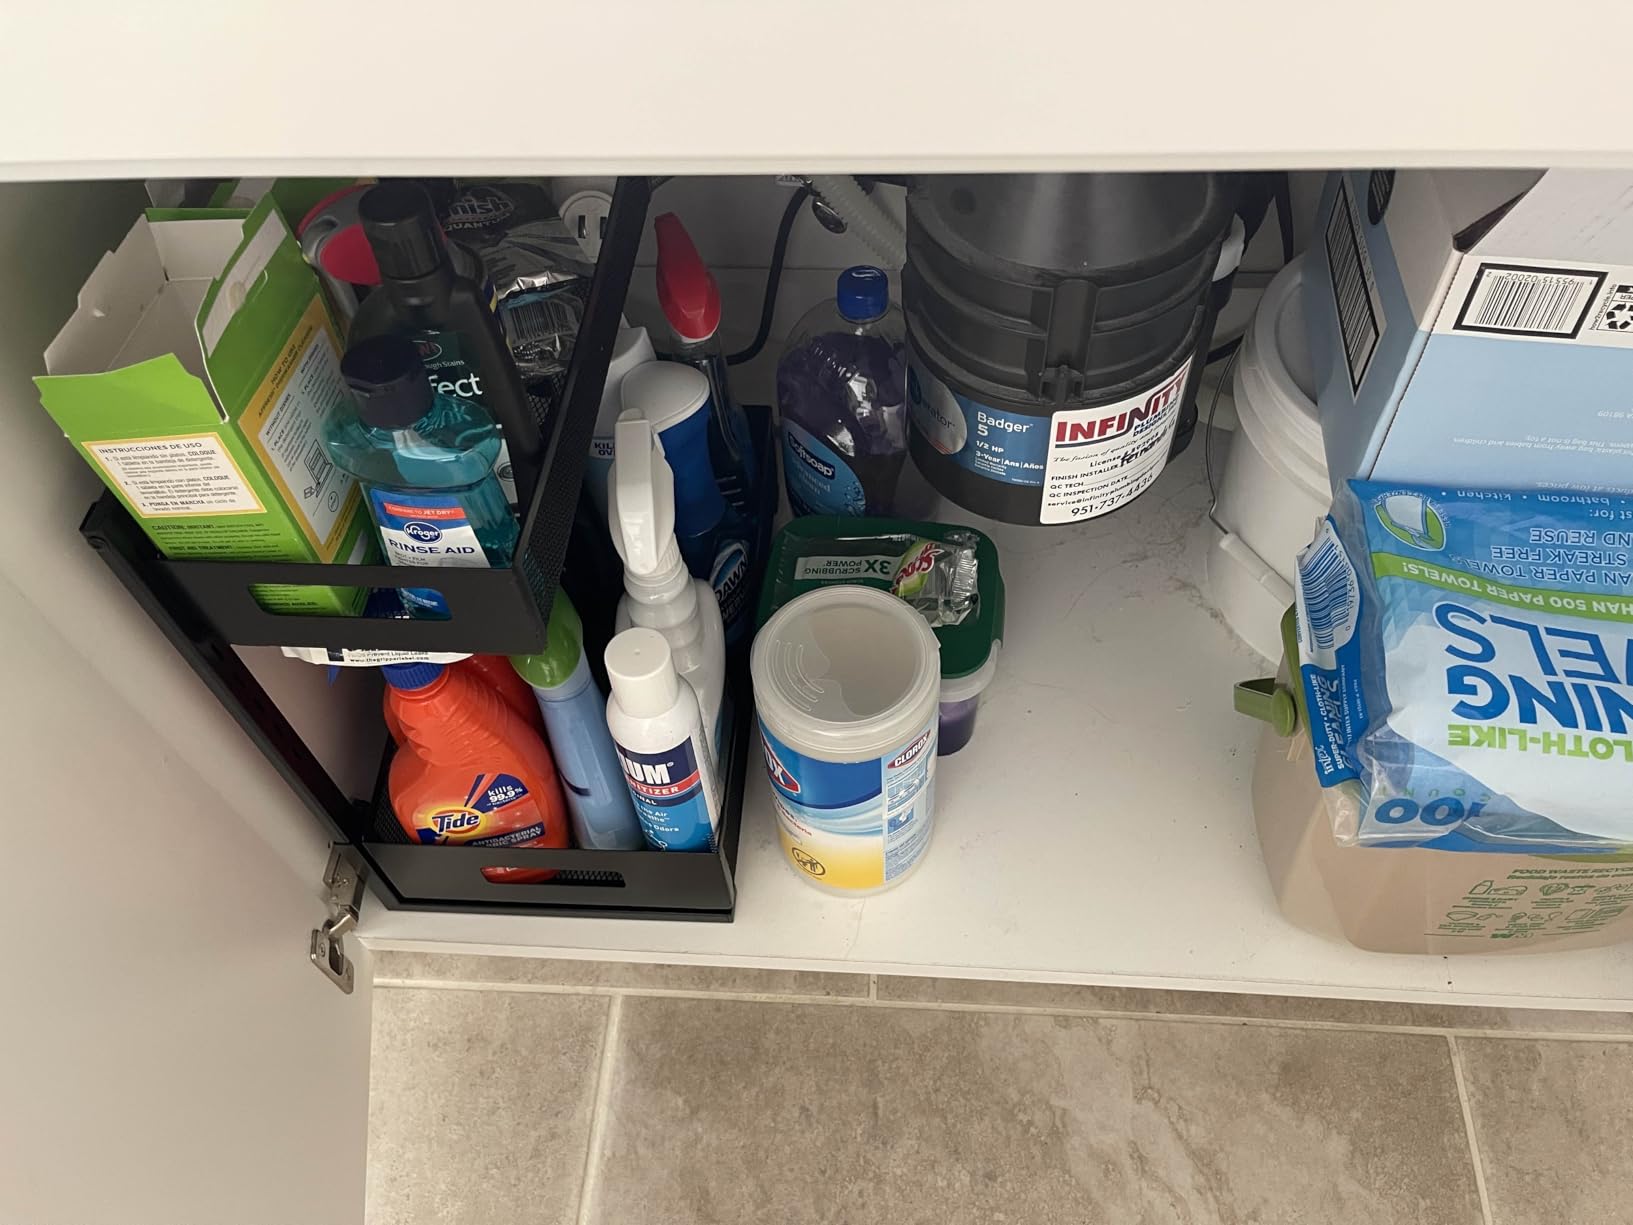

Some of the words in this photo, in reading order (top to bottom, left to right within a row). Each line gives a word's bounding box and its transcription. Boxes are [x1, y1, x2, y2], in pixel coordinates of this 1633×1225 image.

[1505, 273, 1539, 282] 02002
[1543, 275, 1575, 286] 95515
[1055, 366, 1190, 446] INFINITY
[977, 411, 1030, 433] Badger
[977, 424, 989, 436] 5
[99, 445, 169, 454] INSTRUCCIONES
[976, 440, 990, 450] 1/2
[992, 445, 1005, 453] HP
[1089, 455, 1121, 468] License
[1080, 464, 1119, 478] INSTALLER
[1063, 483, 1109, 497] INSPECTION
[1110, 475, 1129, 486] DATE
[1065, 481, 1084, 489] TECH
[1457, 490, 1512, 501] kitchen
[1537, 494, 1610, 506] bathroom
[1588, 508, 1615, 521] for:
[1619, 509, 1633, 521] st
[405, 525, 440, 540] Kroger
[1529, 528, 1597, 545] REUSE
[1602, 530, 1633, 547] ND
[388, 538, 440, 554] RINSE
[445, 546, 475, 554] AID
[1490, 546, 1541, 561] FREE
[825, 560, 862, 568] POWER
[1547, 548, 1628, 567] STREAK
[804, 566, 862, 574] SCRUBBING
[863, 559, 891, 574] 3X
[1402, 562, 1482, 596] TOWELS!
[1533, 566, 1596, 584] PAPER
[1603, 571, 1633, 587] AN
[1486, 583, 1545, 607] PAPER
[1549, 597, 1586, 611] 500
[1592, 600, 1633, 616] HAN
[1434, 602, 1633, 687] ELS
[1446, 664, 1633, 735] NING
[1324, 722, 1344, 769] SUPER-DUTY
[1447, 723, 1633, 763] LOTH-LIKE
[894, 735, 929, 768] CLOROX
[488, 784, 514, 797] kills
[489, 786, 523, 803] 99.9%
[629, 779, 680, 796] NITIZER
[432, 812, 480, 834] Tide
[472, 826, 542, 846] ANTIBACTERIAL
